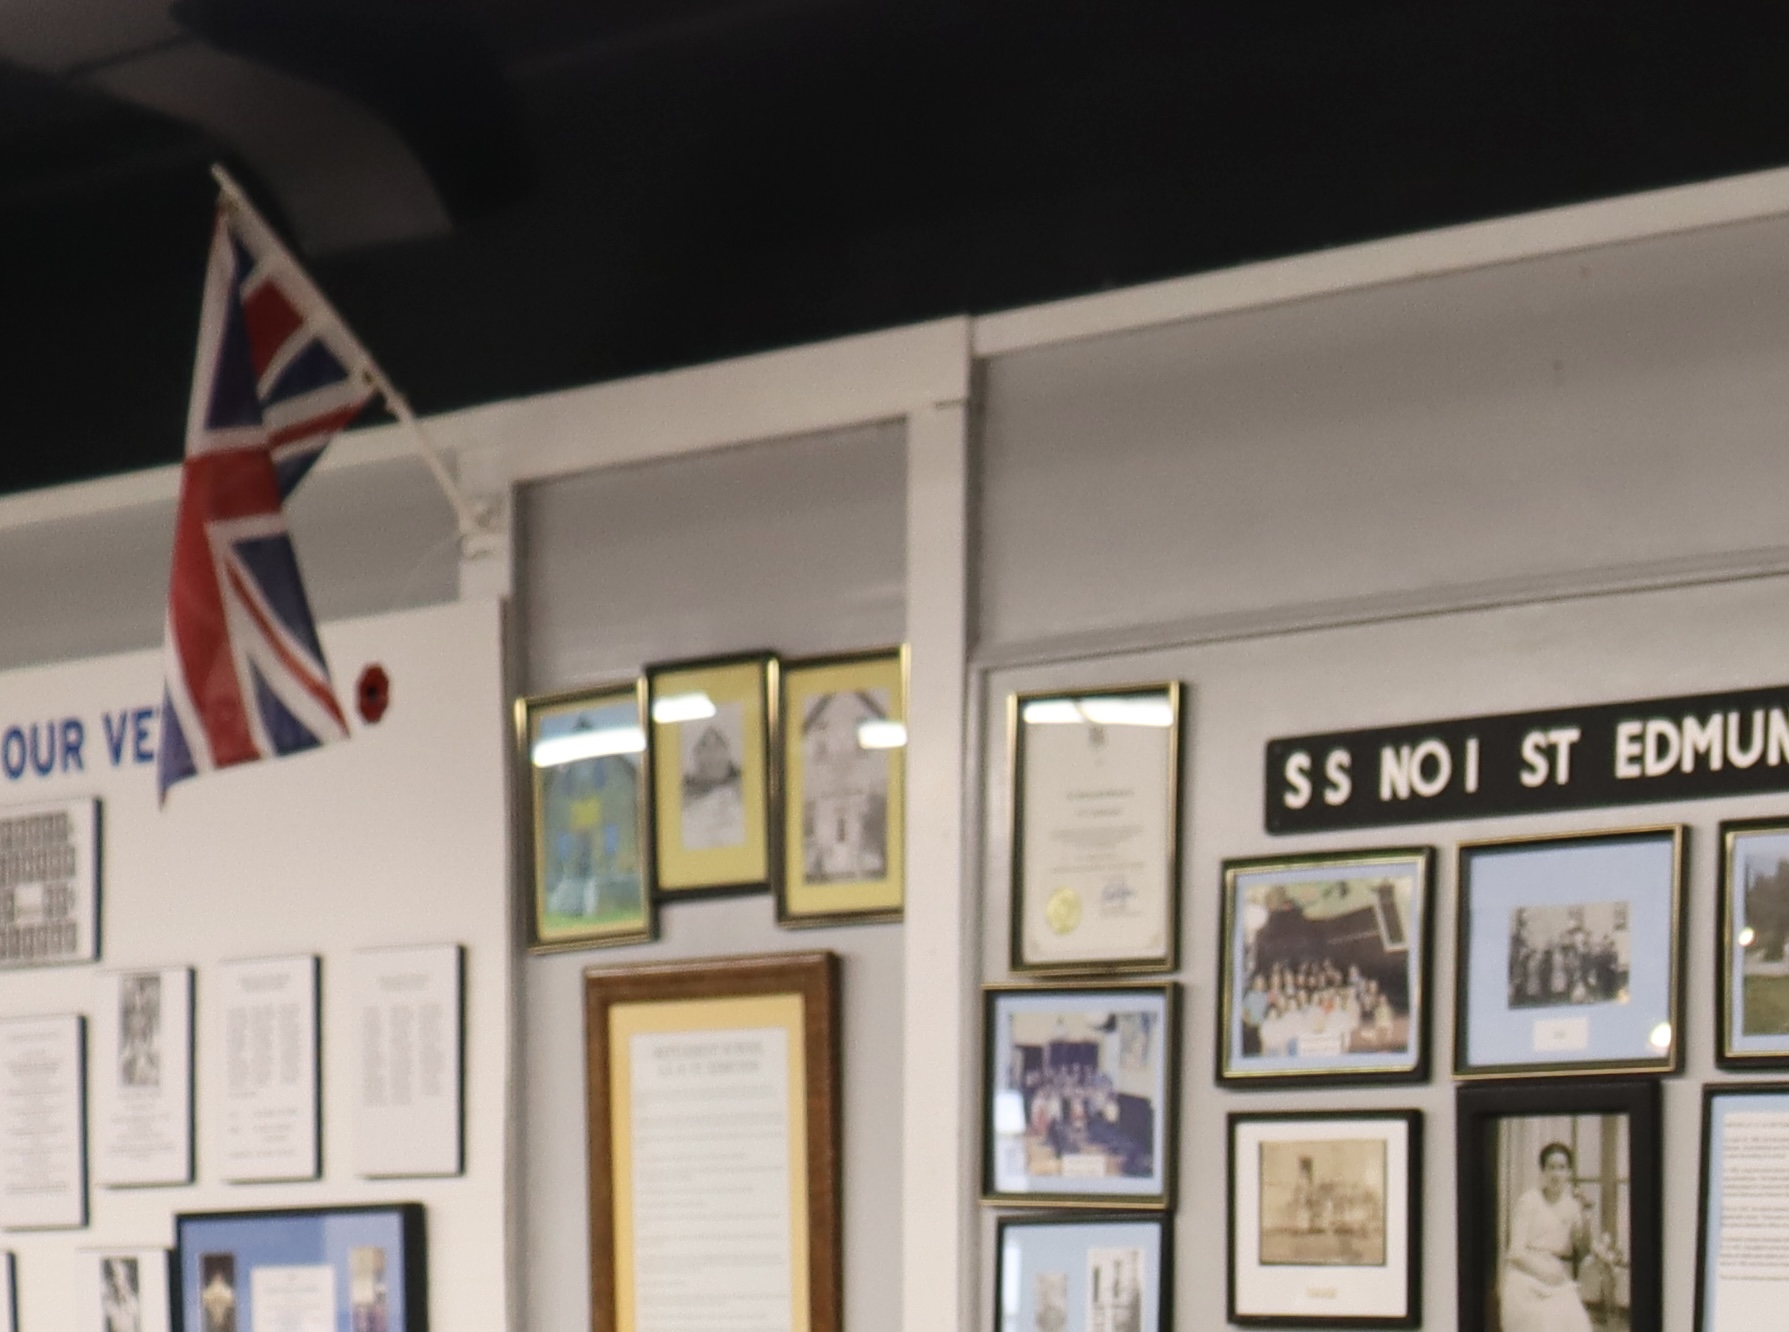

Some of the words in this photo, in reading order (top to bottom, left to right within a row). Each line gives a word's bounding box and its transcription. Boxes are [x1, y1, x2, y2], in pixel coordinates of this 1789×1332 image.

[2, 715, 86, 782] OUR
[101, 706, 160, 768] VE
[1520, 727, 1581, 787] ST
